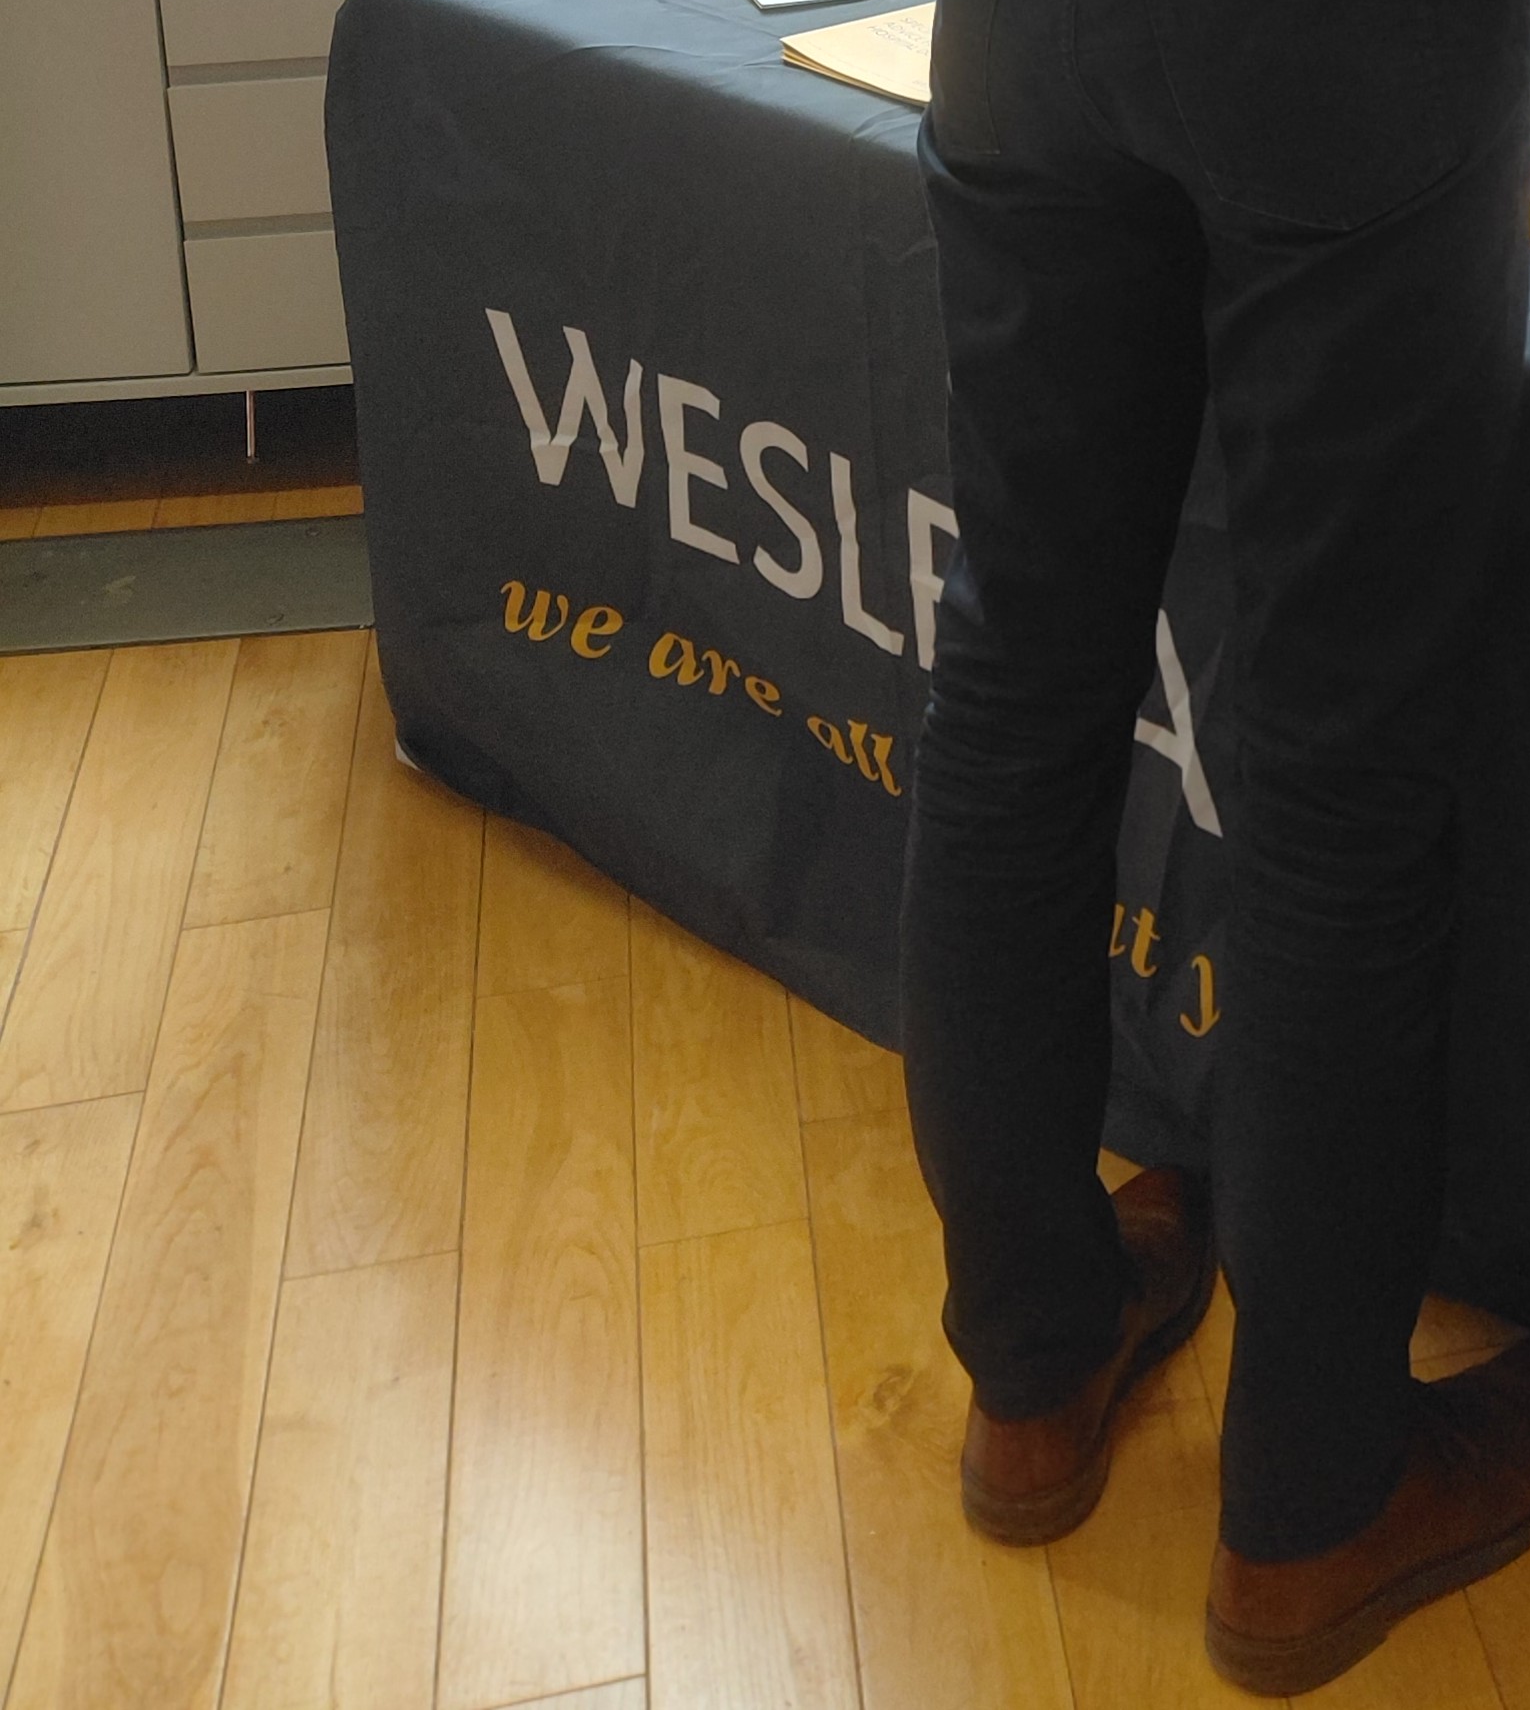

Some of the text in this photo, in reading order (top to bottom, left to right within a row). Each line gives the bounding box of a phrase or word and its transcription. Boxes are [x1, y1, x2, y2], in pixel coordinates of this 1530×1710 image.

[499, 579, 903, 798] we are all
